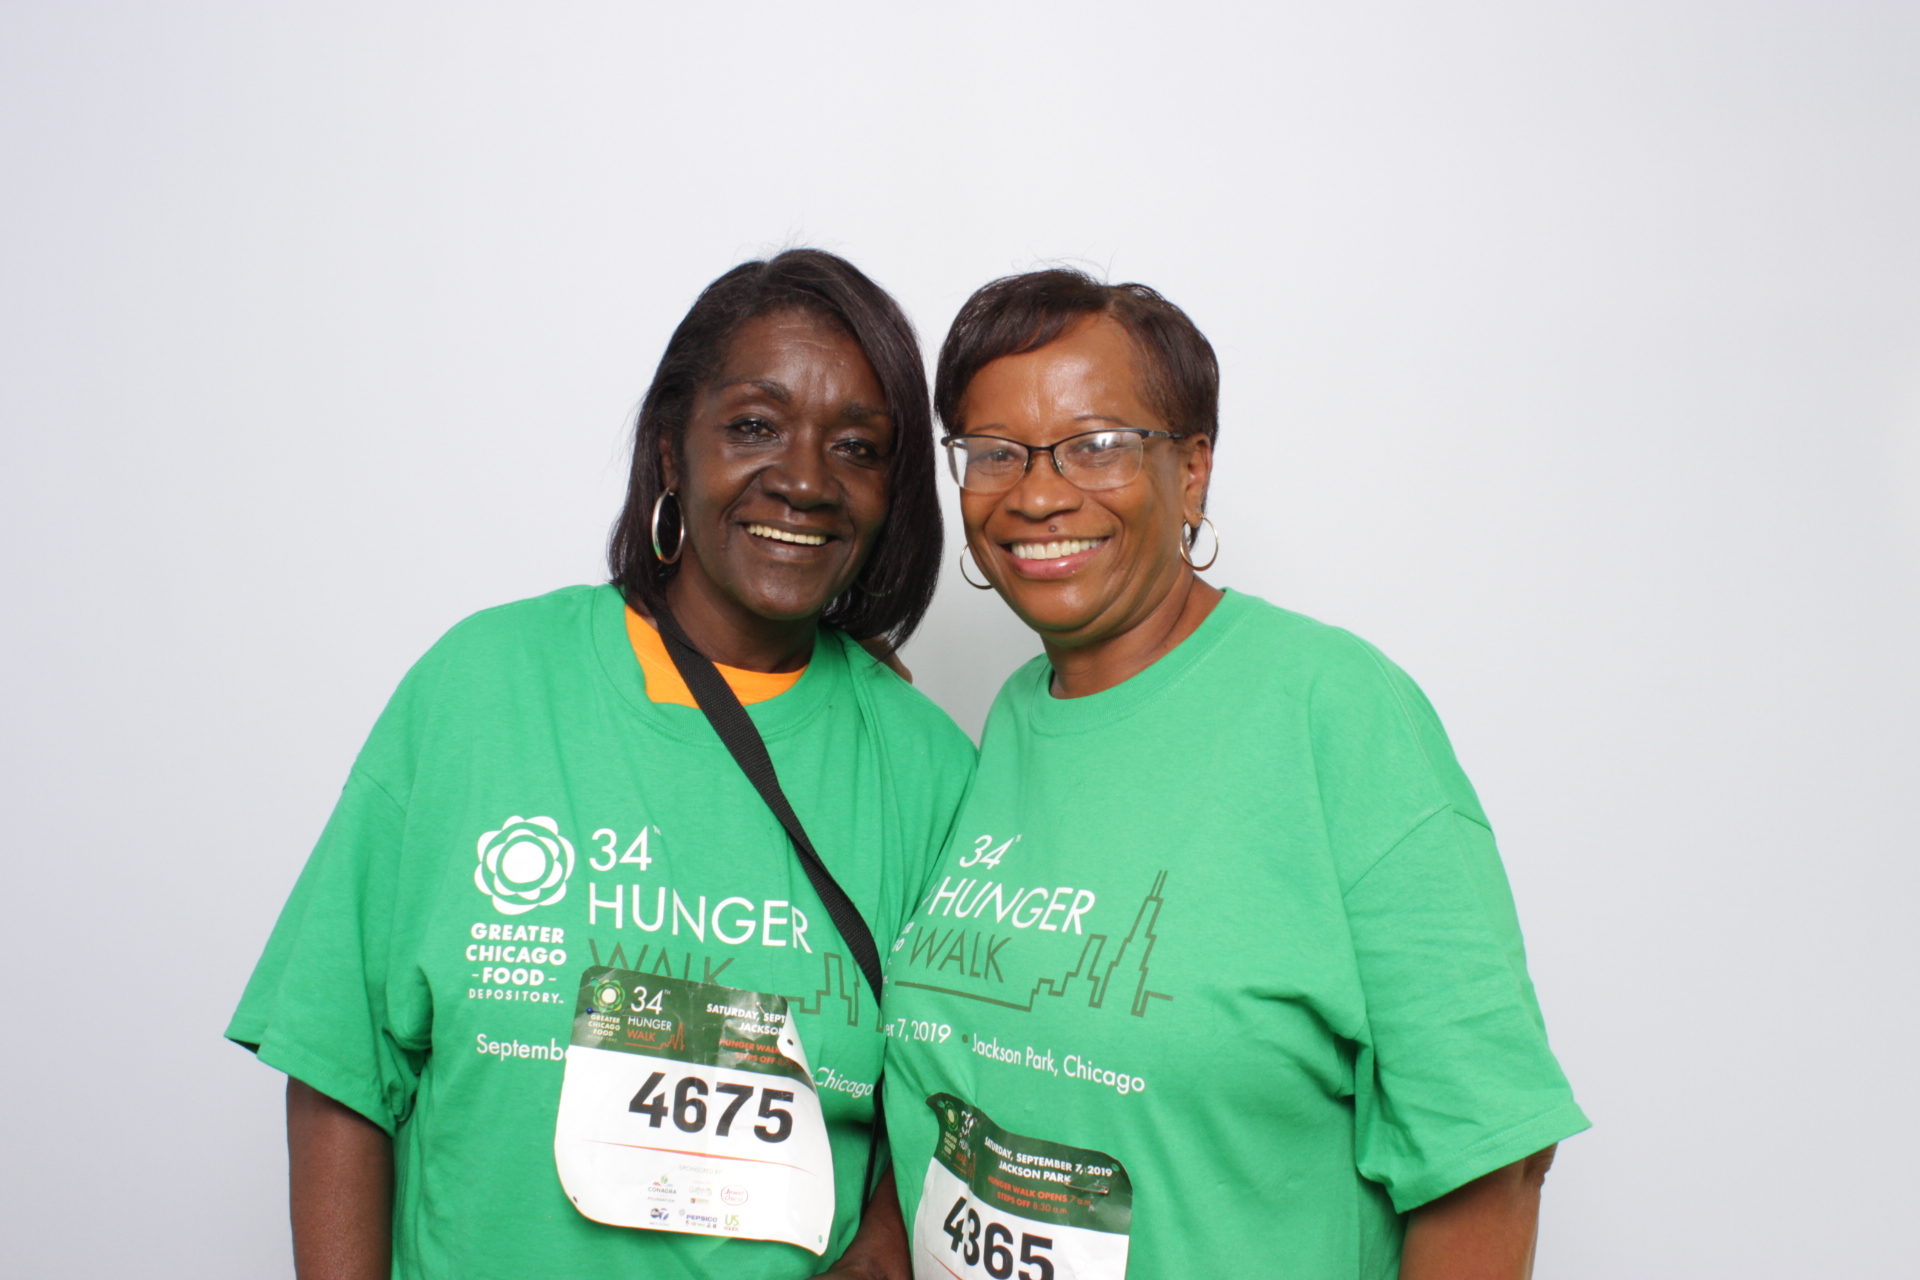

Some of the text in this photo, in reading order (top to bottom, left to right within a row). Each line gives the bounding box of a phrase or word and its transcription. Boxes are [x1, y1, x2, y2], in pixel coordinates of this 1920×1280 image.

[927, 876, 1096, 935] HUNGER
[589, 881, 813, 954] HUNGER
[470, 922, 565, 944] GREATER
[465, 944, 567, 966] CHICAGO
[909, 926, 1012, 983] WALK
[590, 1013, 621, 1024] GREATER
[627, 1016, 672, 1031] HUNGER
[706, 1003, 760, 1022] SATURDAY,
[588, 1020, 621, 1031] CHICAGO
[626, 1028, 656, 1042] WALK
[911, 1020, 952, 1044] 2019
[476, 1033, 568, 1062] Septemb
[971, 1033, 1146, 1095] Jackson Park, Chicago
[814, 1066, 875, 1099] Chicago
[628, 1071, 794, 1144] 4675
[998, 1160, 1041, 1180] JACKSON
[1016, 1153, 1073, 1172] SEPTEMBER
[1087, 1165, 1113, 1177] 2019
[1013, 1186, 1036, 1198] WALK
[1037, 1191, 1068, 1203] OPENS
[1016, 1198, 1032, 1208] OFF
[686, 1214, 718, 1223] PEPSICO
[943, 1196, 1055, 1280] 4365
